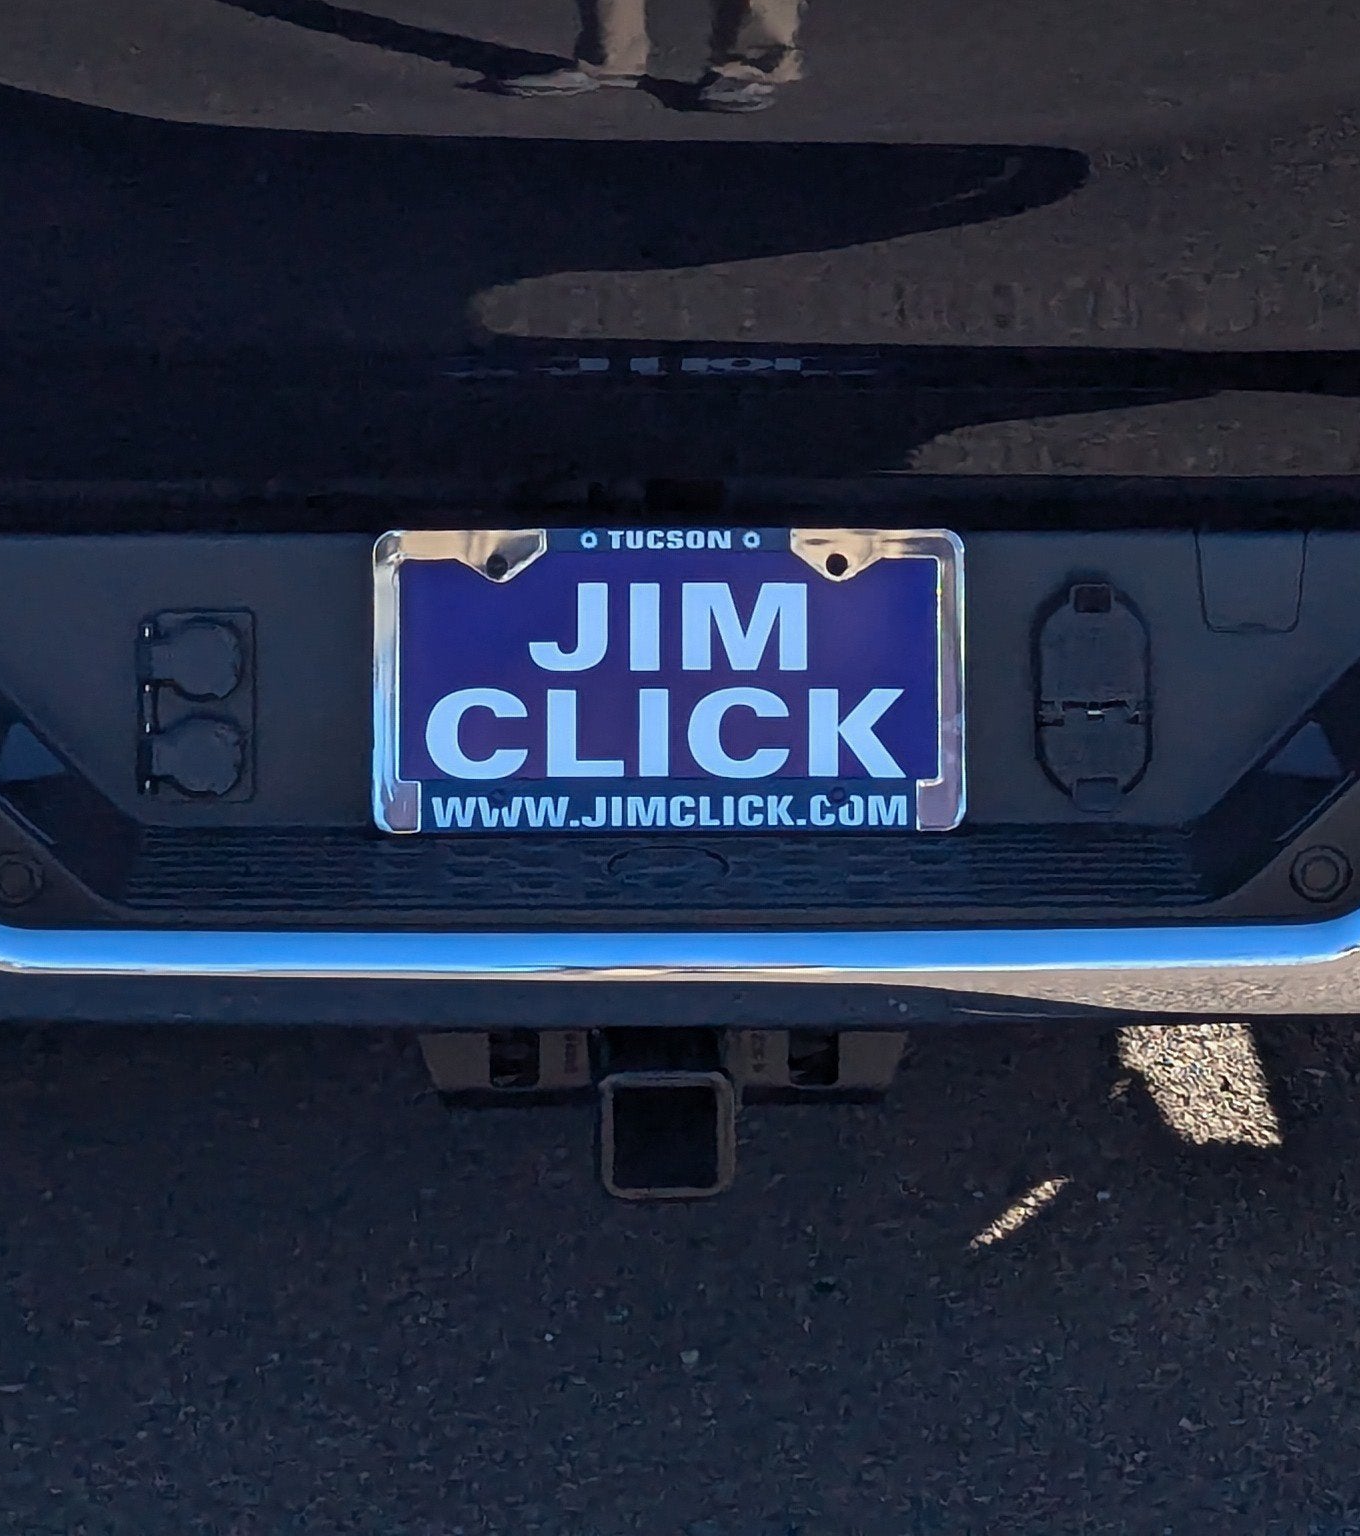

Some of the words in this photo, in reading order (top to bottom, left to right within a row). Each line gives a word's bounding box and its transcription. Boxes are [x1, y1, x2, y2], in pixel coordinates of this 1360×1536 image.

[607, 529, 733, 551] TUCSON
[528, 582, 808, 673] JIM
[425, 687, 907, 780] CLICK
[431, 794, 909, 829] WWW.JIMCLICK.COM
